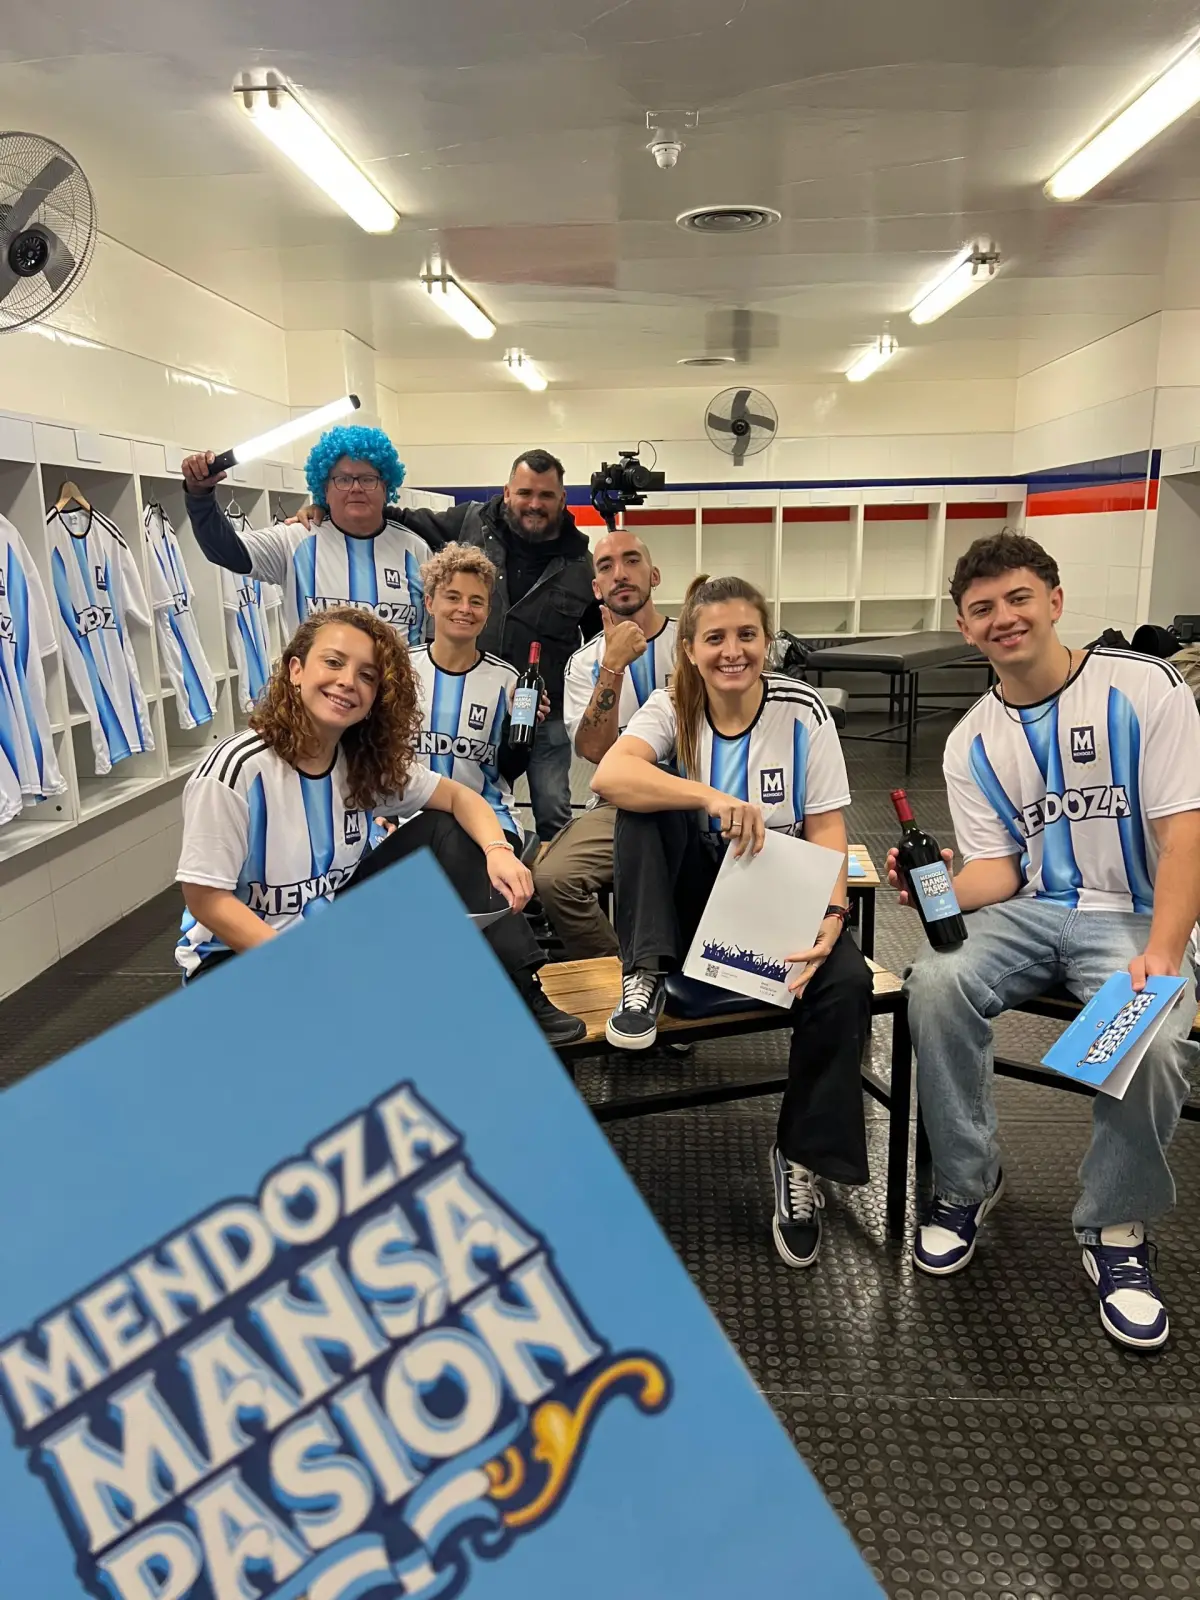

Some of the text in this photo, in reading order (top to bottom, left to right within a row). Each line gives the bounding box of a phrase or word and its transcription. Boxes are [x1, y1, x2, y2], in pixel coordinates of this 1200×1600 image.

[471, 706, 486, 722] M
[411, 731, 497, 767] ENDOZA
[1073, 730, 1094, 751] M
[763, 772, 783, 792] M
[0, 1082, 463, 1430] MENDOZA
[42, 1160, 541, 1555] MANSA
